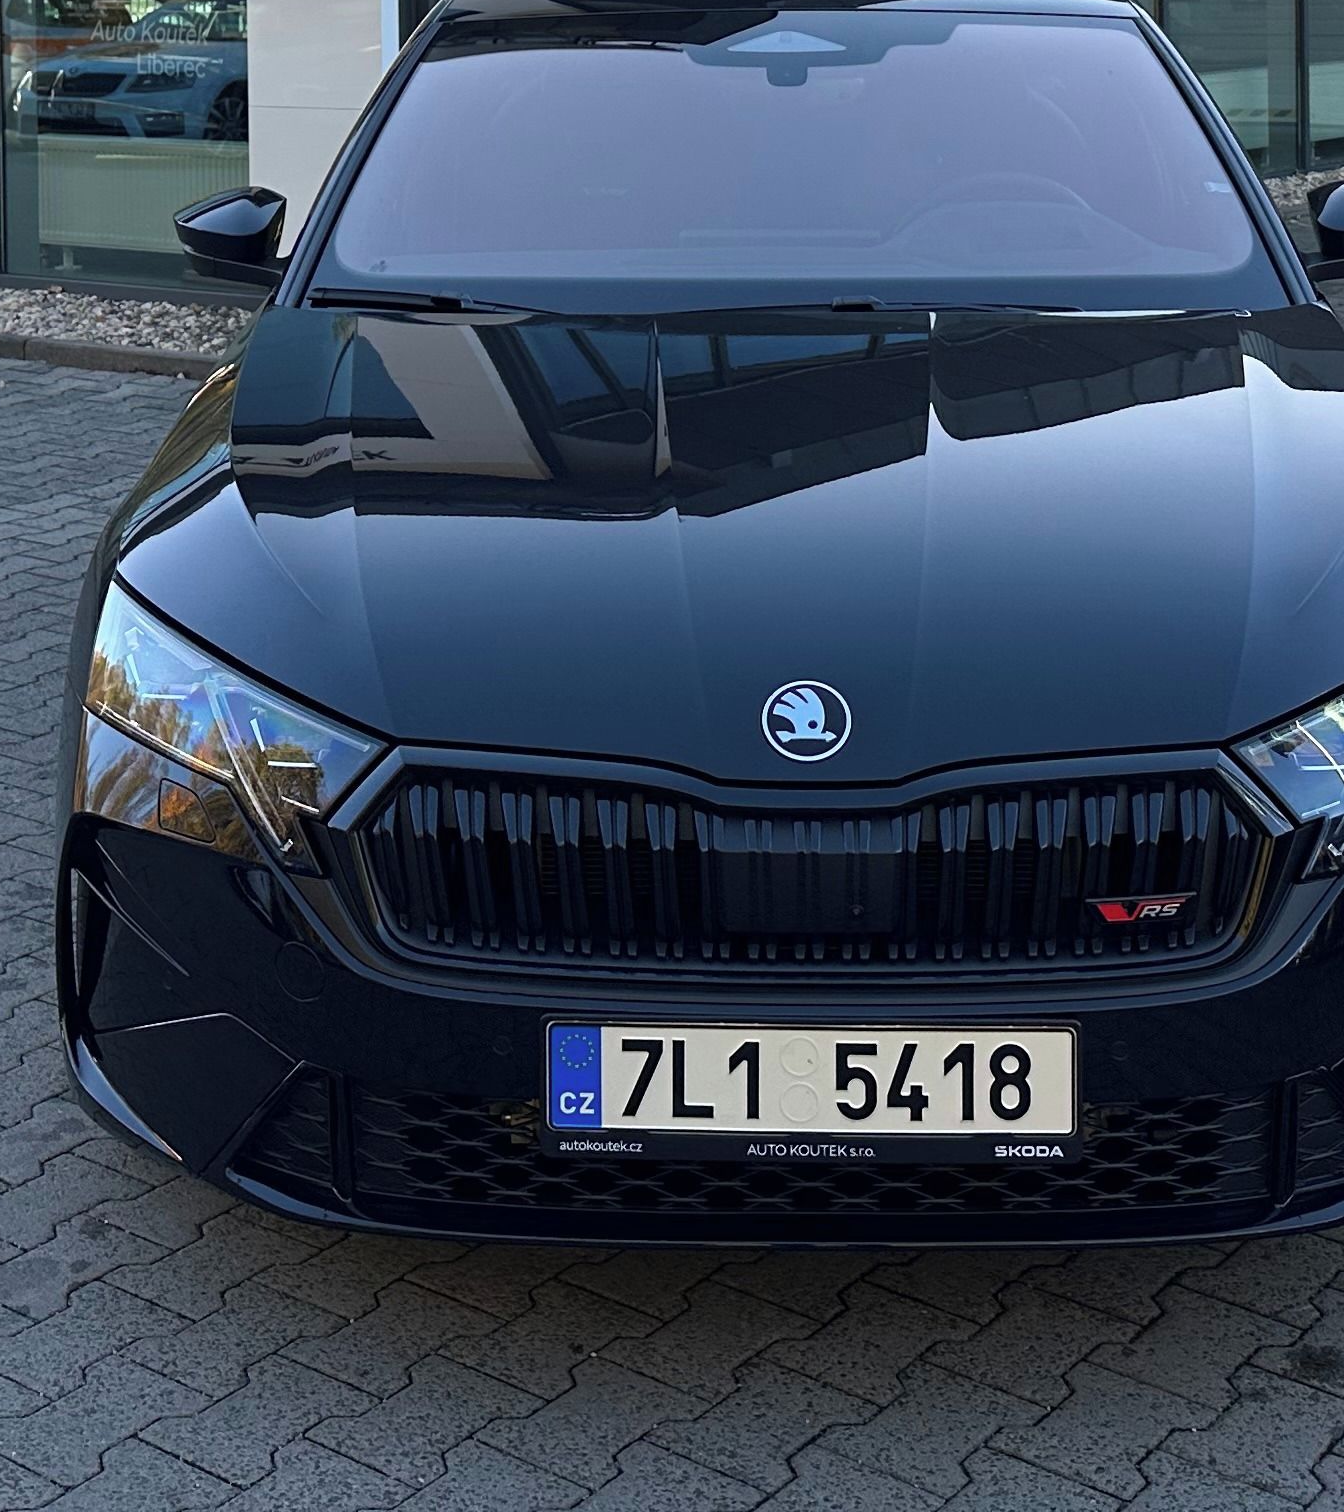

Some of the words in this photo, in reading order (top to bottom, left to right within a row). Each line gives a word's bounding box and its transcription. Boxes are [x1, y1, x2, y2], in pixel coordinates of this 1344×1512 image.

[90, 19, 136, 42] Auto
[141, 20, 208, 46] Koutek
[136, 52, 206, 78] Liberec
[559, 1091, 595, 1115] CZ
[620, 1039, 761, 1120] 7L1
[835, 1041, 1033, 1122] 5418
[559, 1138, 643, 1153] autokoutek.cz
[746, 1144, 786, 1156] AUTO
[789, 1144, 847, 1157] KOUTEK
[850, 1146, 877, 1157] s.r.o.
